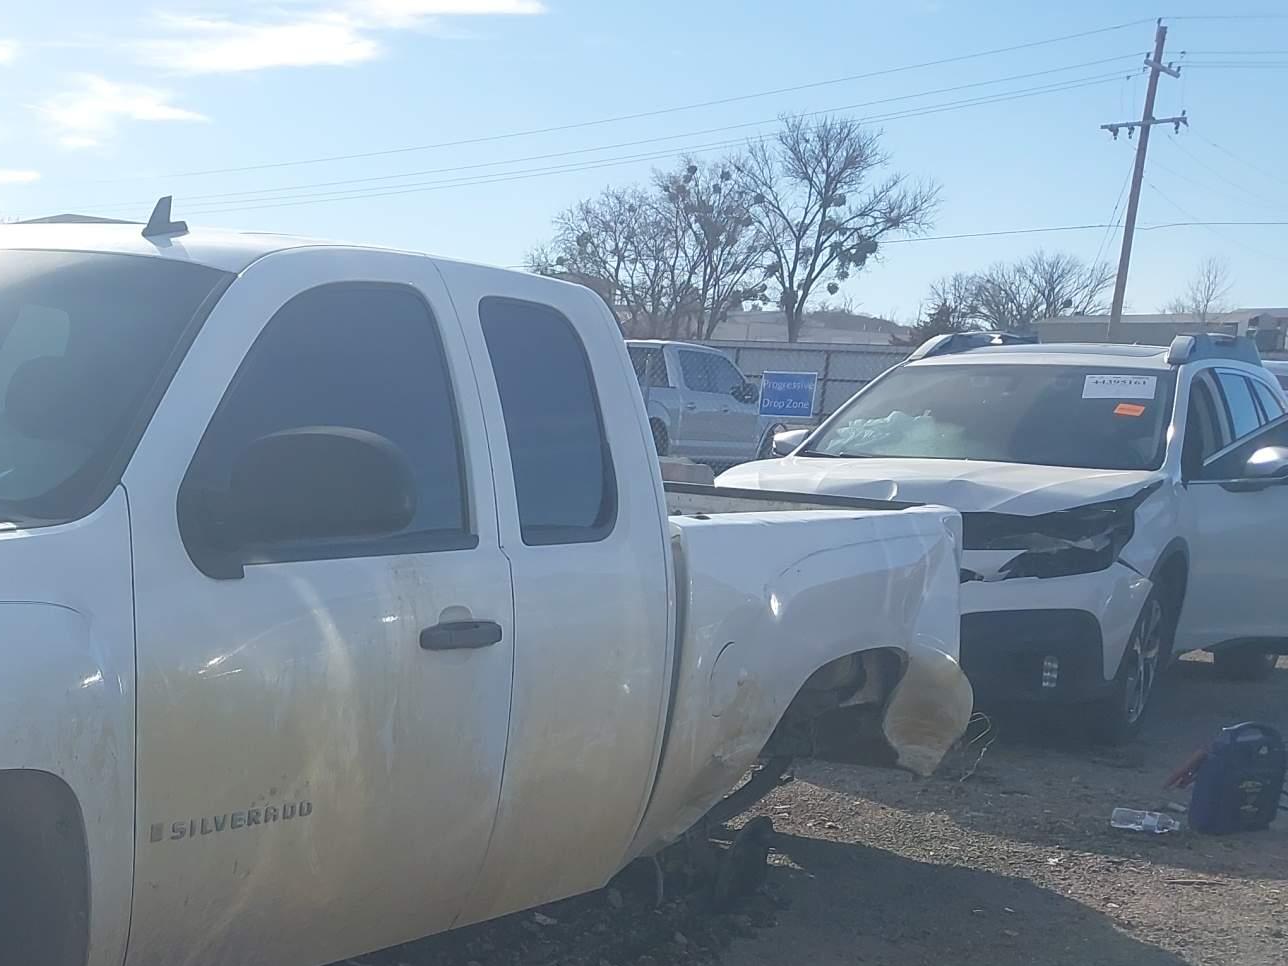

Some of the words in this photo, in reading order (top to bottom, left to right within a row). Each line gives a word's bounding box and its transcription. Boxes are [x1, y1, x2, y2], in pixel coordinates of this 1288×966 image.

[763, 380, 815, 391] Progressive
[762, 399, 785, 409] Drop
[785, 399, 810, 409] Zone
[170, 800, 313, 841] SILVERADO
